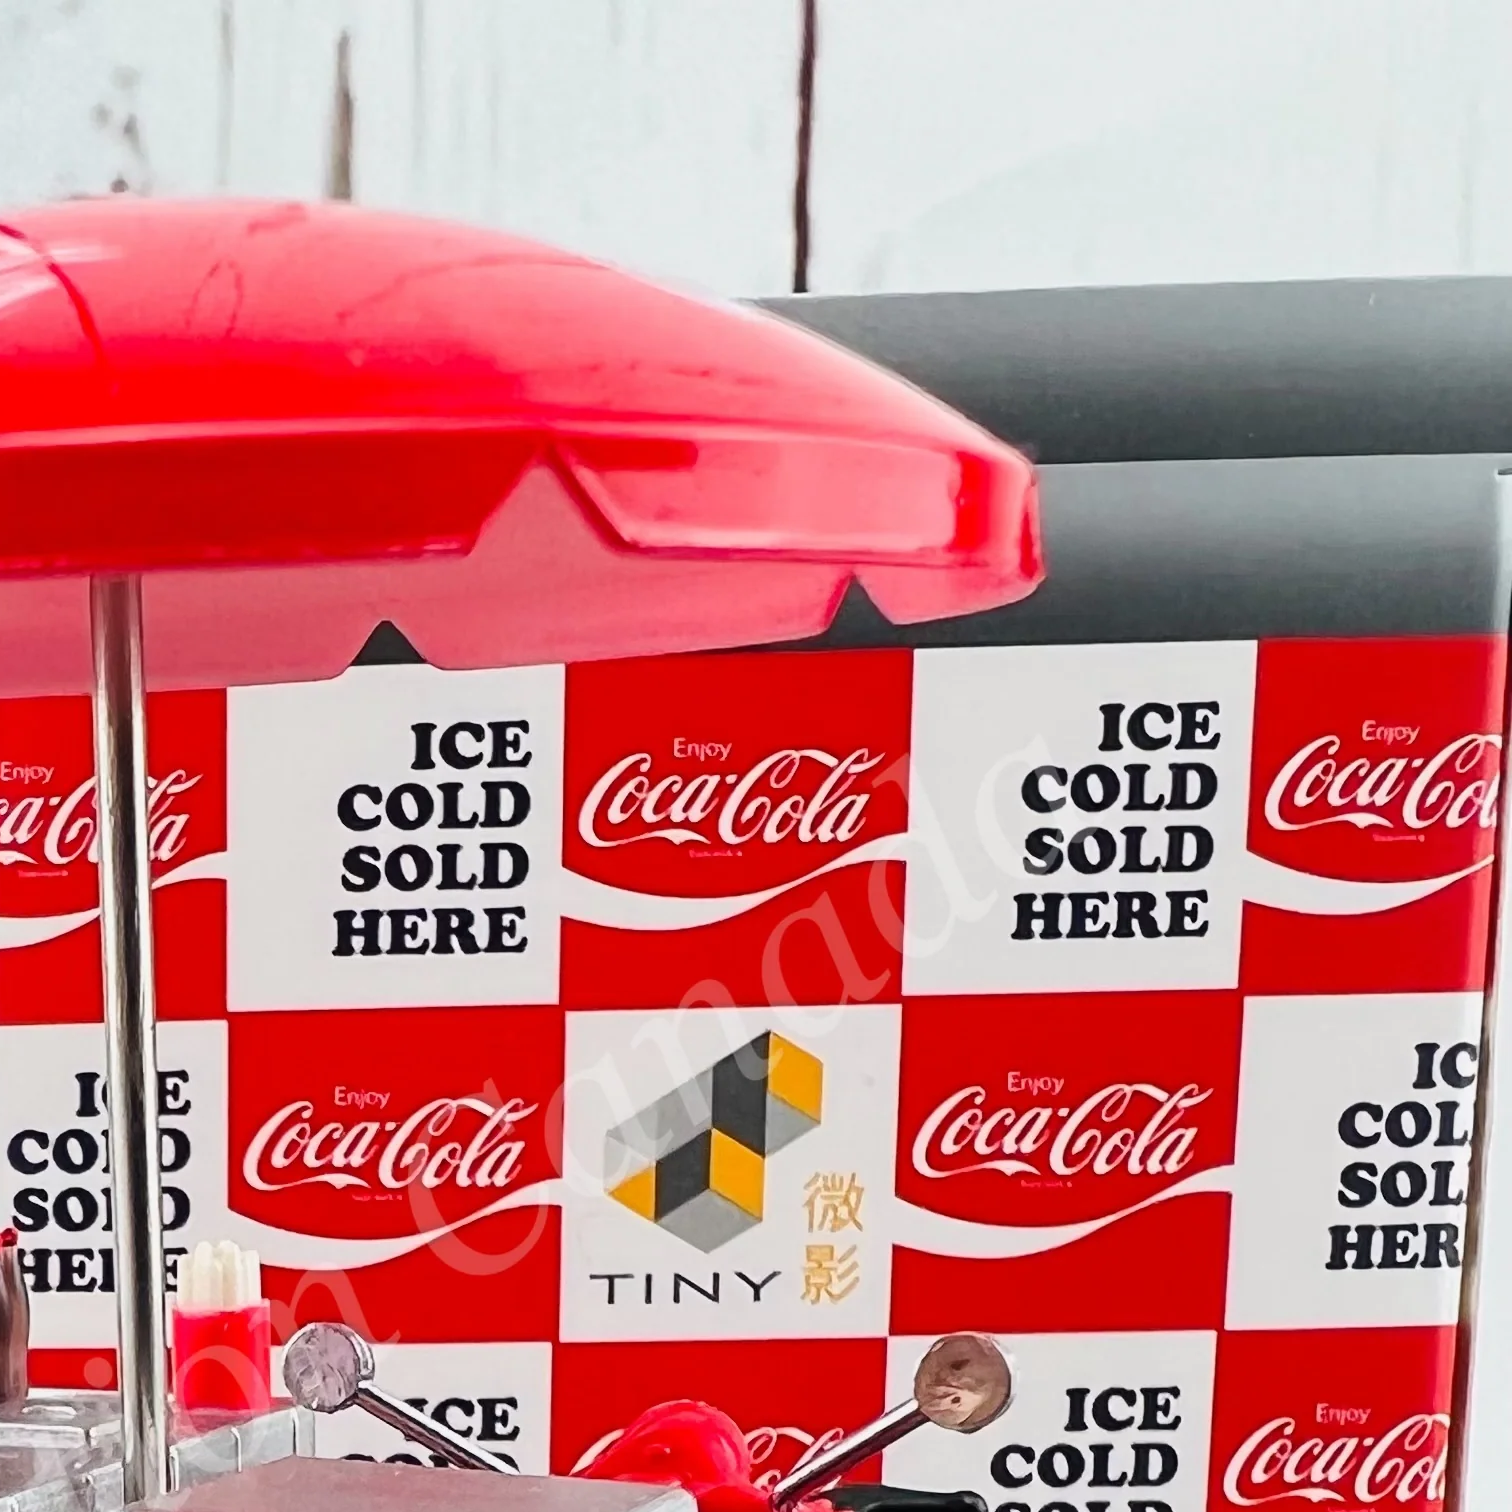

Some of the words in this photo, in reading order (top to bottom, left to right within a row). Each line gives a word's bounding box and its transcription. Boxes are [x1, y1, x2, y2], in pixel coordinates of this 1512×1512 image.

[411, 720, 532, 770] ICE
[673, 738, 732, 761] Enjoy
[1098, 701, 1220, 751] ICE
[1362, 720, 1420, 745] Enjoy
[0, 761, 55, 784] Enjoy
[1022, 763, 1217, 813] COLD
[1265, 734, 1502, 830] Coca-Col
[338, 781, 530, 831] COLD
[578, 748, 886, 847] Coca-Cola
[342, 843, 529, 892] SOLD
[1023, 826, 1213, 875] SOLD
[332, 906, 527, 956] HERE
[1011, 890, 1208, 940] HERE
[1007, 1072, 1065, 1096] Enjoy
[1412, 1042, 1477, 1089] IC
[75, 1069, 191, 1117] IE
[334, 1086, 390, 1109] Enjoy
[243, 1097, 539, 1191] Coca-Cola
[911, 1083, 1215, 1179] Coca-Cola
[1338, 1101, 1468, 1148] COL
[1338, 1161, 1464, 1208] SOL
[800, 1172, 864, 1305] 微影
[1325, 1223, 1461, 1270] HER
[589, 1271, 781, 1304] TINY
[1064, 1386, 1181, 1431] ICE
[1316, 1402, 1371, 1425] Enjoy
[991, 1443, 1178, 1488] COLD
[1223, 1413, 1451, 1506] Coca-Col
